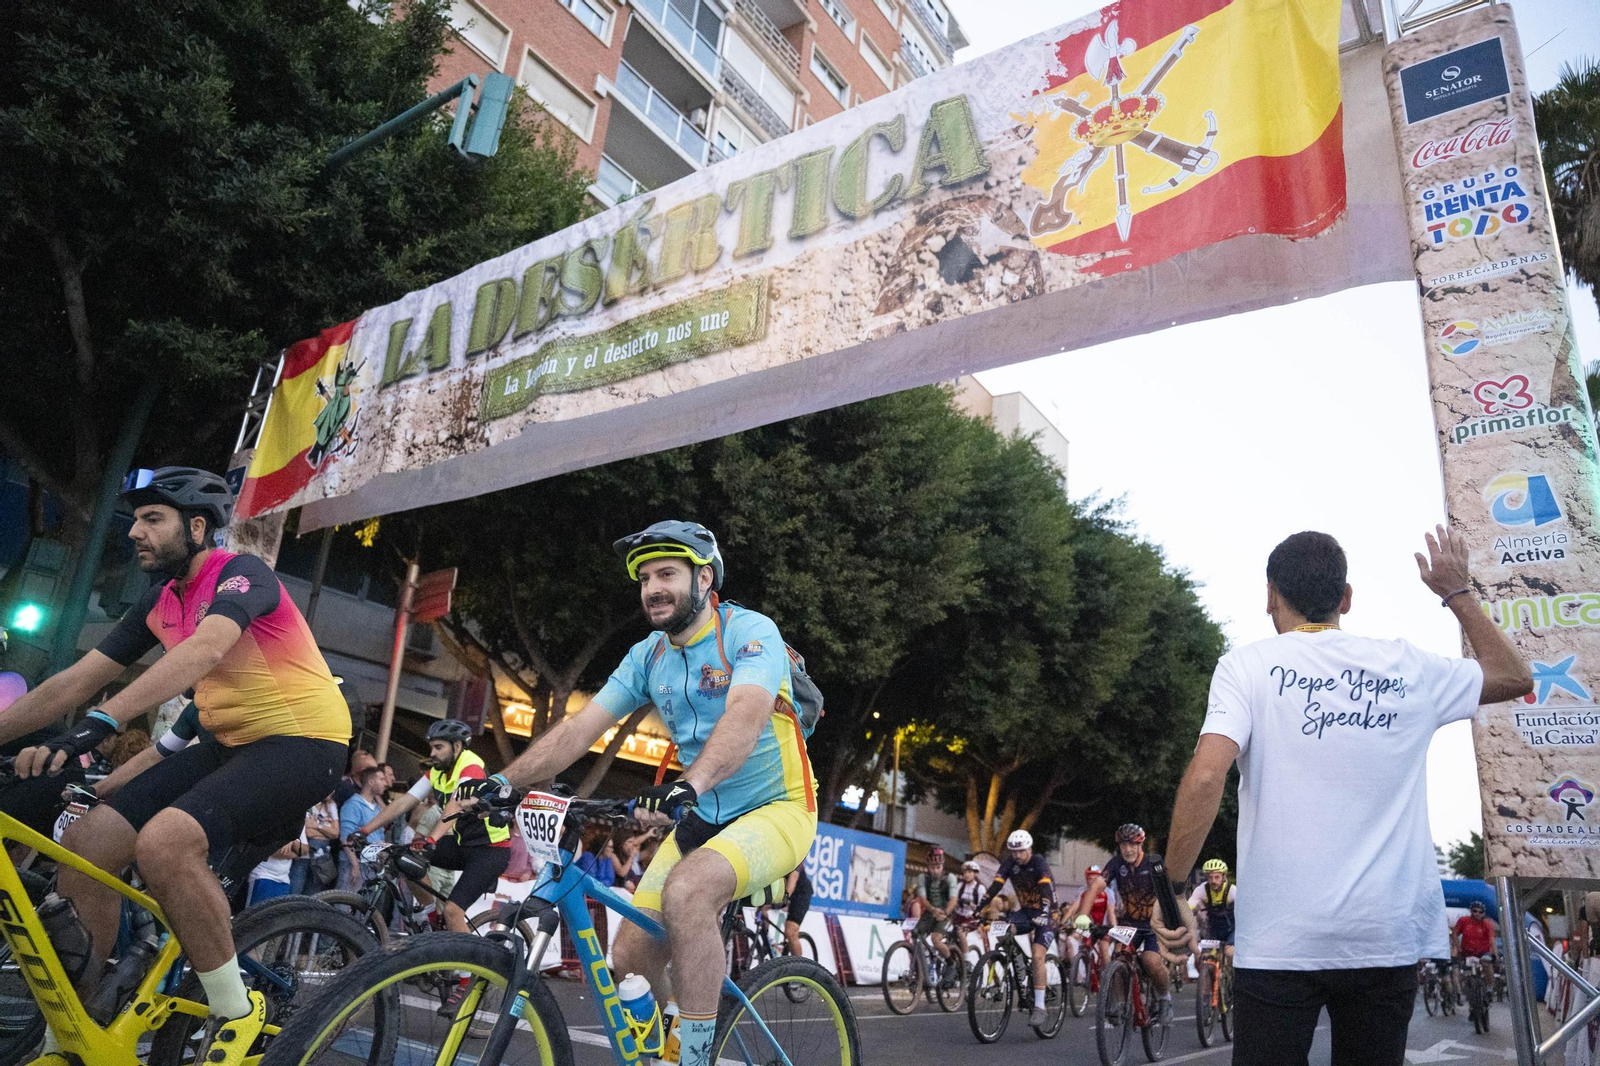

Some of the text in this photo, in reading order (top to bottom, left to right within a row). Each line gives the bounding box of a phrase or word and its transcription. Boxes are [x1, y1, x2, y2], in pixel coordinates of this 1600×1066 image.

[1425, 75, 1482, 99] SENATOR
[1412, 116, 1516, 169] Coca-Cola
[1423, 167, 1518, 200] GRUPO
[1424, 181, 1526, 222] RENTA
[379, 93, 992, 387] LA DESÉRTICA
[1427, 203, 1529, 244] TODO
[1484, 267, 1517, 279] comercial
[1484, 309, 1551, 331] Andalucía
[1485, 331, 1507, 341] Región
[1509, 326, 1534, 337] Europeo
[504, 375, 518, 396] La
[565, 356, 578, 376] y
[584, 351, 597, 370] el
[604, 331, 659, 364] desierto
[666, 320, 692, 343] nos
[700, 310, 729, 333] une
[1455, 407, 1572, 444] primaflor
[1493, 531, 1568, 551] Almería
[1501, 548, 1565, 565] Activa
[659, 684, 672, 694] Bar
[714, 675, 729, 683] Bar
[1270, 665, 1407, 705] Pepe Yepes
[1302, 700, 1398, 739] Speaker
[523, 811, 559, 843] 5998
[1506, 824, 1600, 834] COSTADEAL
[805, 833, 844, 876] gar
[577, 927, 643, 1066] FOCU
